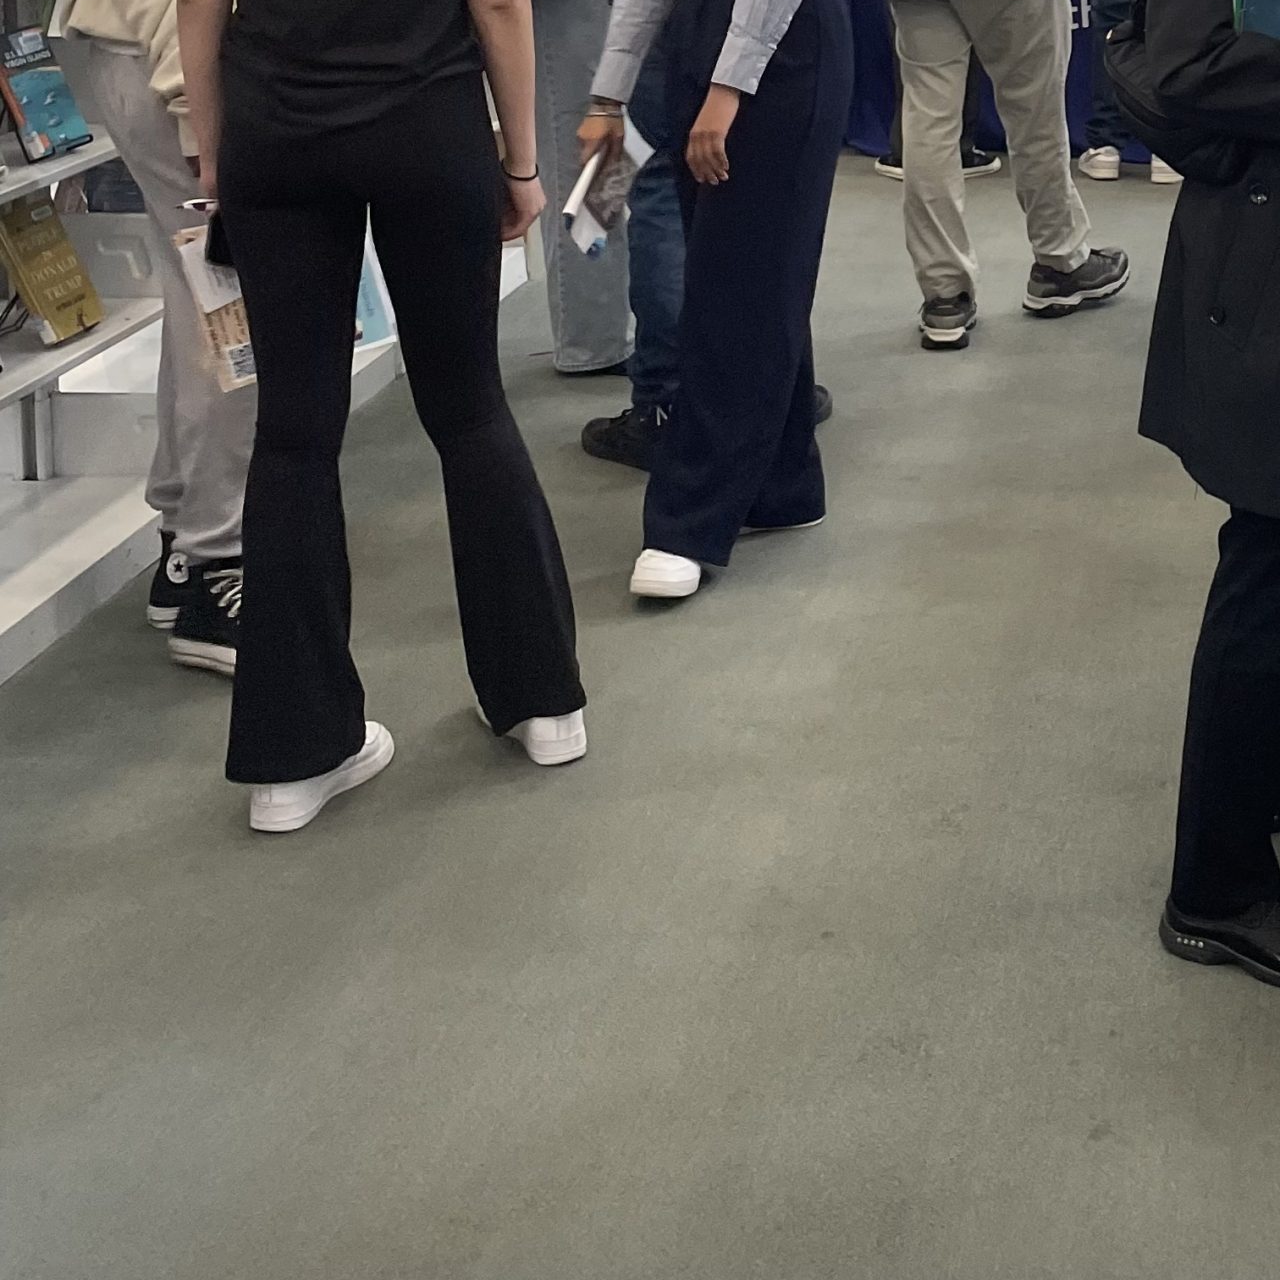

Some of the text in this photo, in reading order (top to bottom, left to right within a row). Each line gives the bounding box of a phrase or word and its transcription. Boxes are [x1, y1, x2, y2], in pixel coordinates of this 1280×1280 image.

[4, 57, 27, 69] VIRGIN
[26, 50, 52, 63] ISLANDS
[30, 256, 78, 282] DONALD
[44, 274, 82, 301] TRUMP
